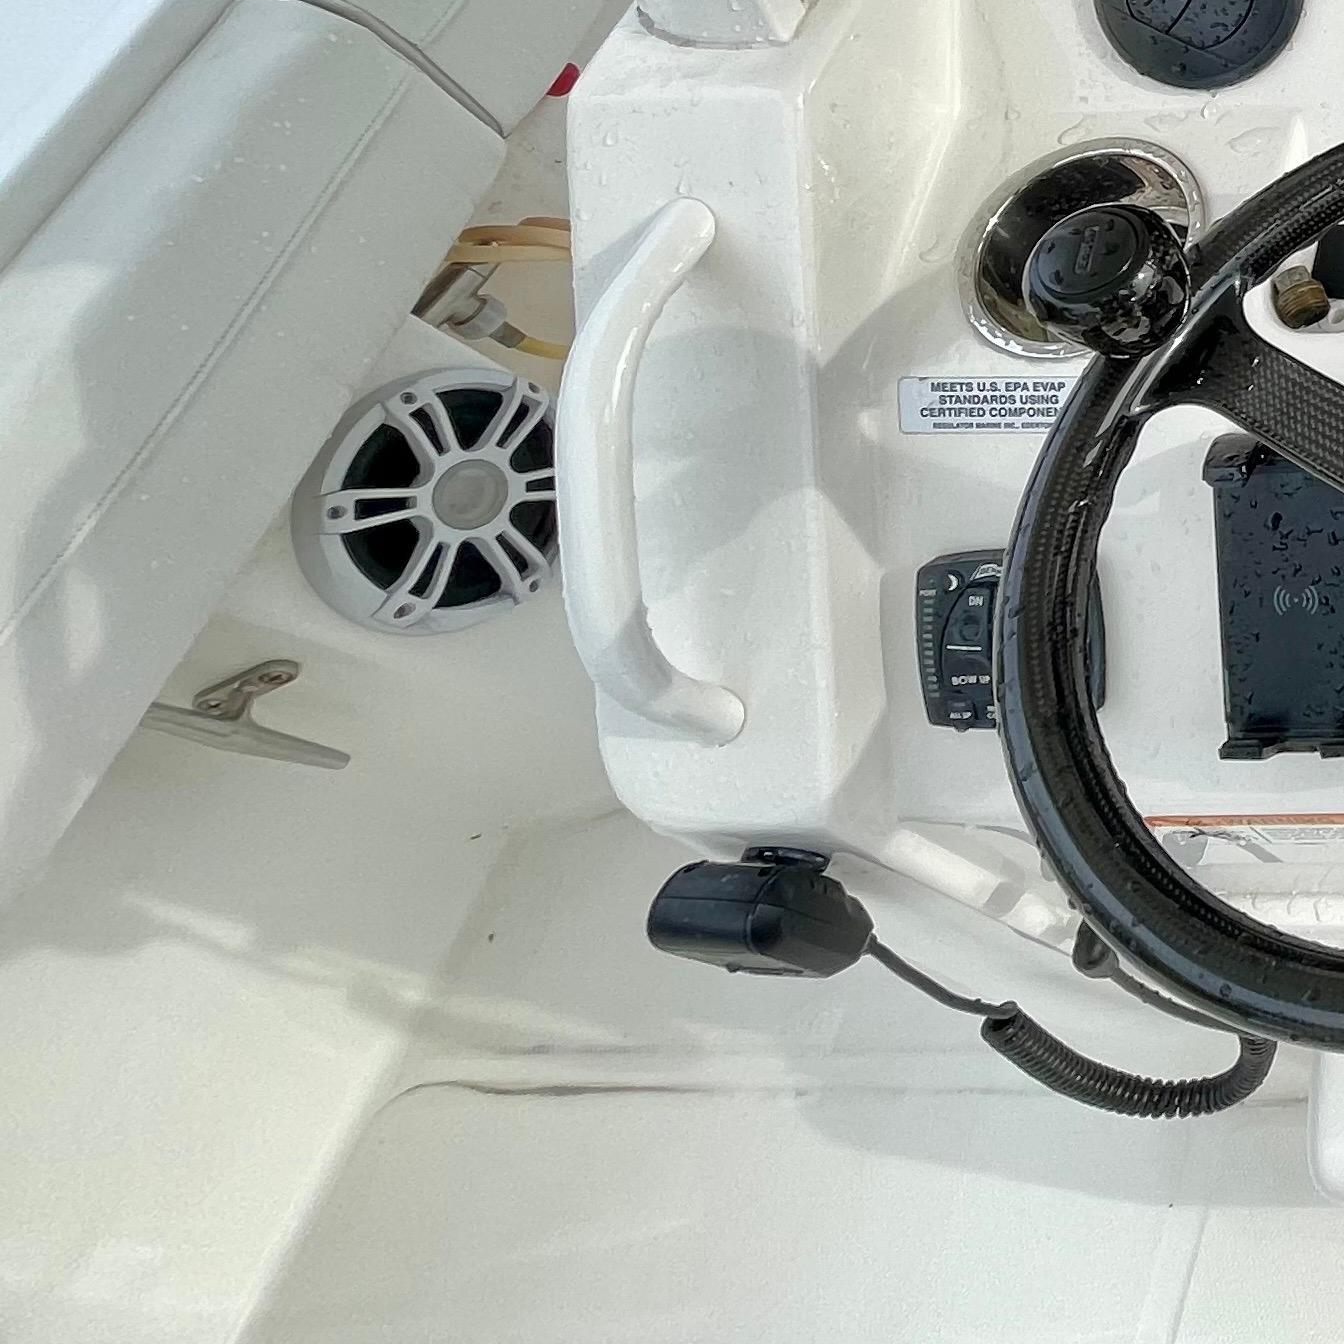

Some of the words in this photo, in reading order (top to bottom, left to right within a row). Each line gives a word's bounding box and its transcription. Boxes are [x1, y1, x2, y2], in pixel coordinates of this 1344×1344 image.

[931, 382, 973, 392] MEETS
[977, 382, 1001, 392] U.S.
[1005, 382, 1029, 392] EPA
[1033, 382, 1065, 392] EVAP
[939, 395, 1016, 405] STANDARDS
[1019, 395, 1059, 405] USING
[920, 408, 986, 417] CERTIFIED
[951, 676, 977, 685] BOW
